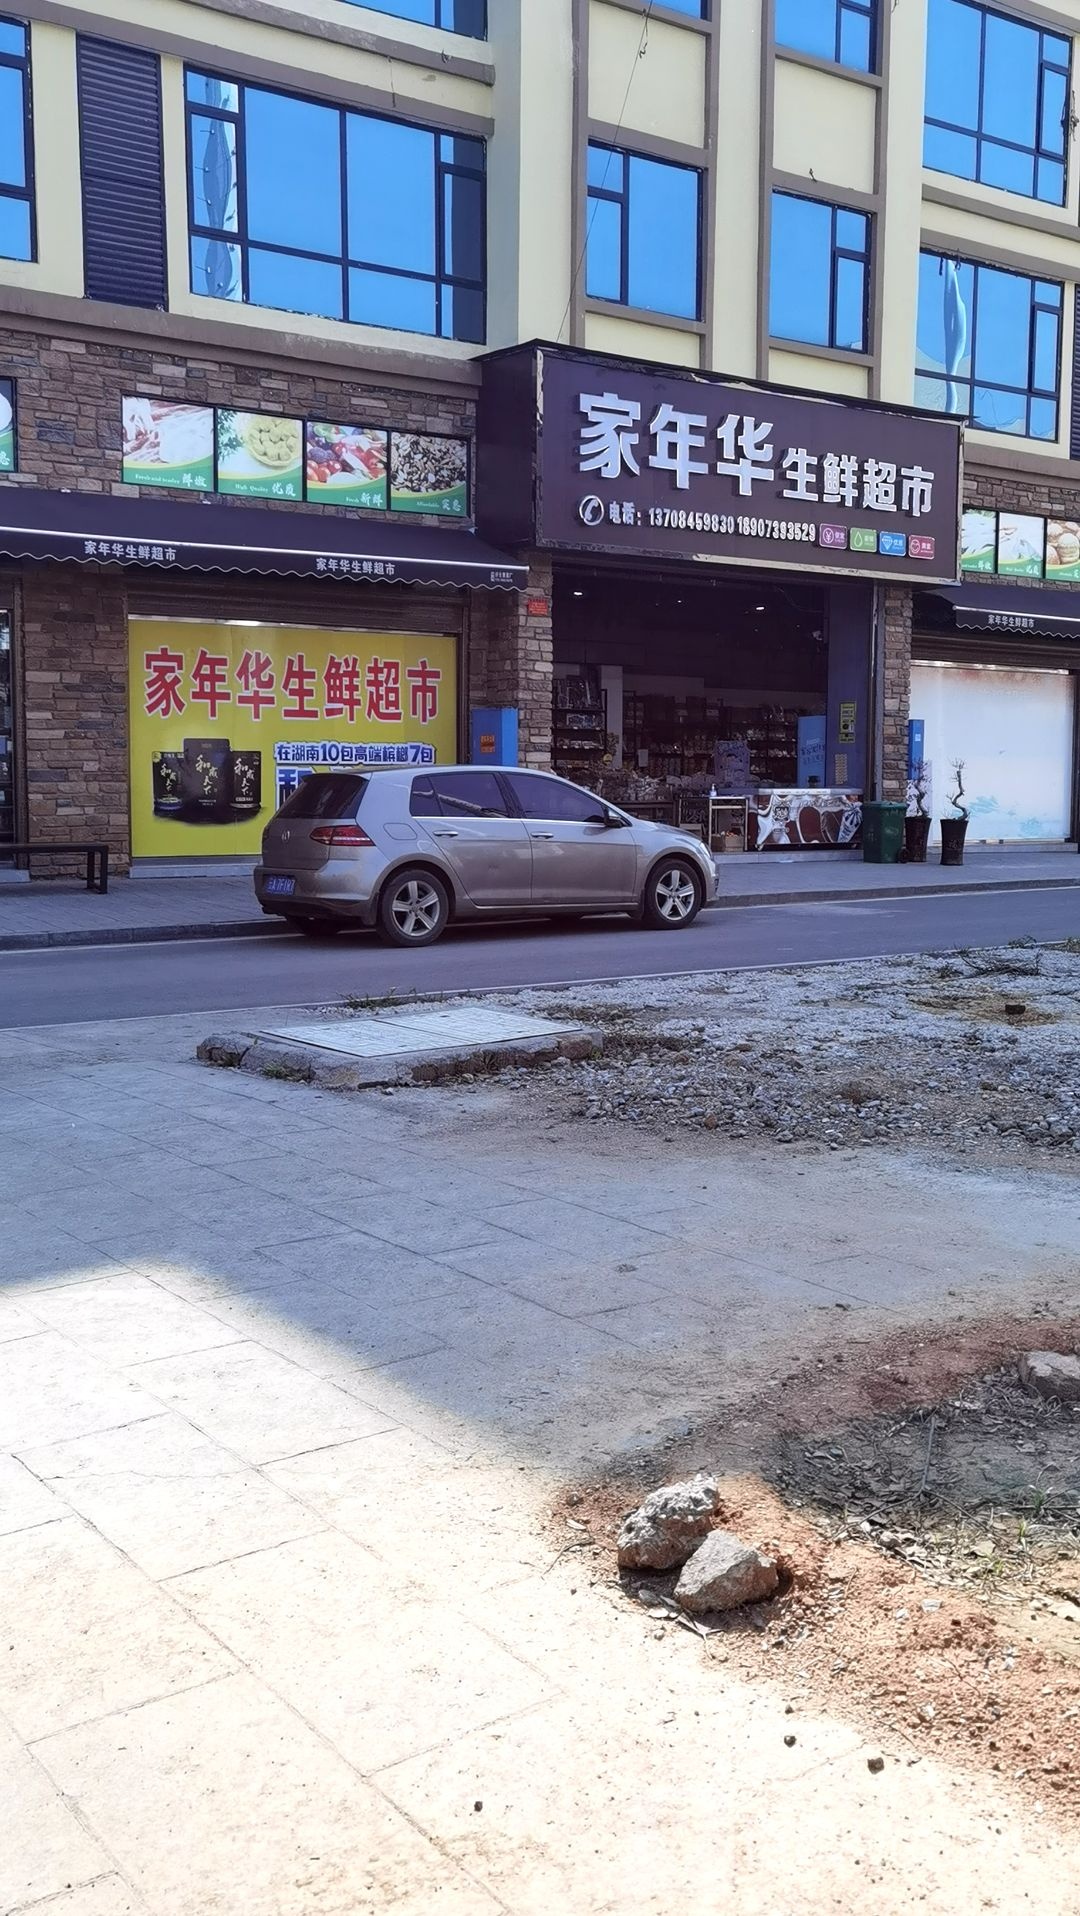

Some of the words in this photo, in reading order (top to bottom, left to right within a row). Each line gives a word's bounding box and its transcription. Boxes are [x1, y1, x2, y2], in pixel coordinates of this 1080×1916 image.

[360, 491, 383, 507] 新鲜
[649, 507, 735, 534] 13708459830
[84, 540, 177, 562] 家年华生鲜超市
[315, 557, 396, 576] 家年华生鲜超市
[988, 614, 1035, 628] 家年华生鲜超市
[143, 646, 442, 725] 家年华生鲜超市
[277, 743, 433, 763] 在湖南10包高端槟榔7包
